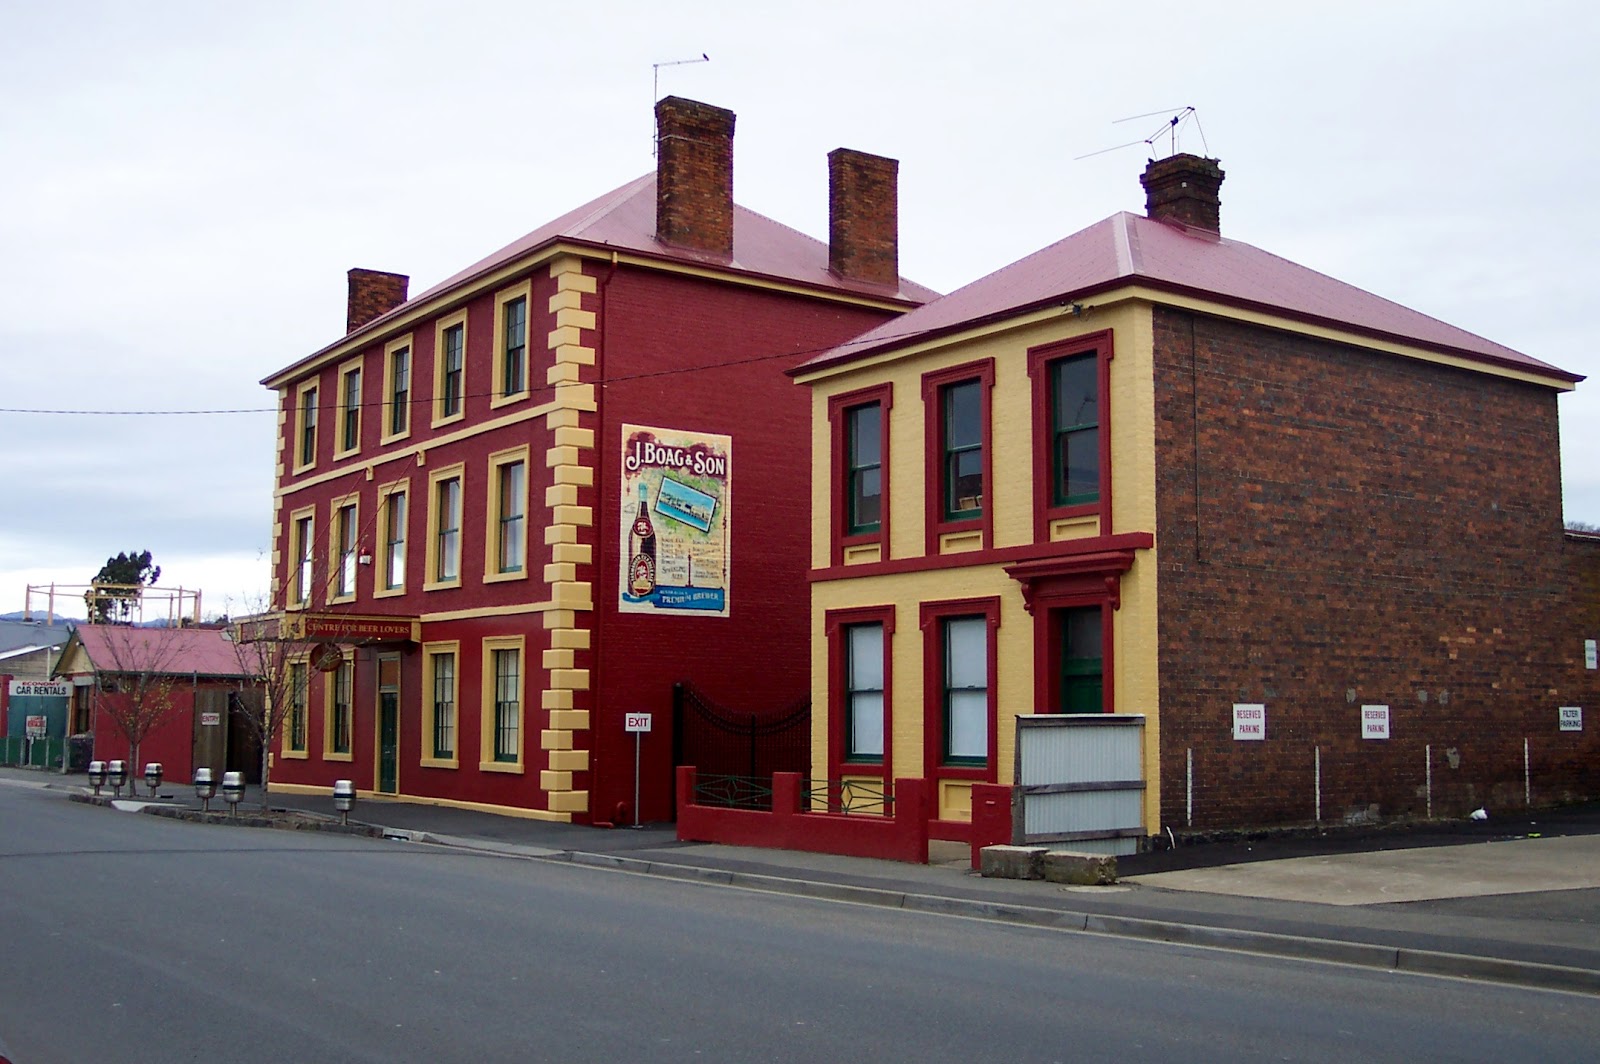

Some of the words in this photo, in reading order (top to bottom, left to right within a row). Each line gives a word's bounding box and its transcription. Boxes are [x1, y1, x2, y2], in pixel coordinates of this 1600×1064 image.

[694, 451, 725, 475] SON
[359, 624, 378, 632] BEER
[380, 625, 409, 633] LOVERS
[16, 686, 31, 695] CAR
[34, 686, 67, 695] RENTALS
[1236, 710, 1261, 719] RESERVED
[1364, 710, 1386, 720] RESERVED
[1563, 710, 1578, 718] FILTER
[628, 717, 648, 727] EXIT
[1561, 720, 1581, 728] PARKING
[1239, 724, 1260, 734] PARKING
[1366, 724, 1385, 733] PARKING
